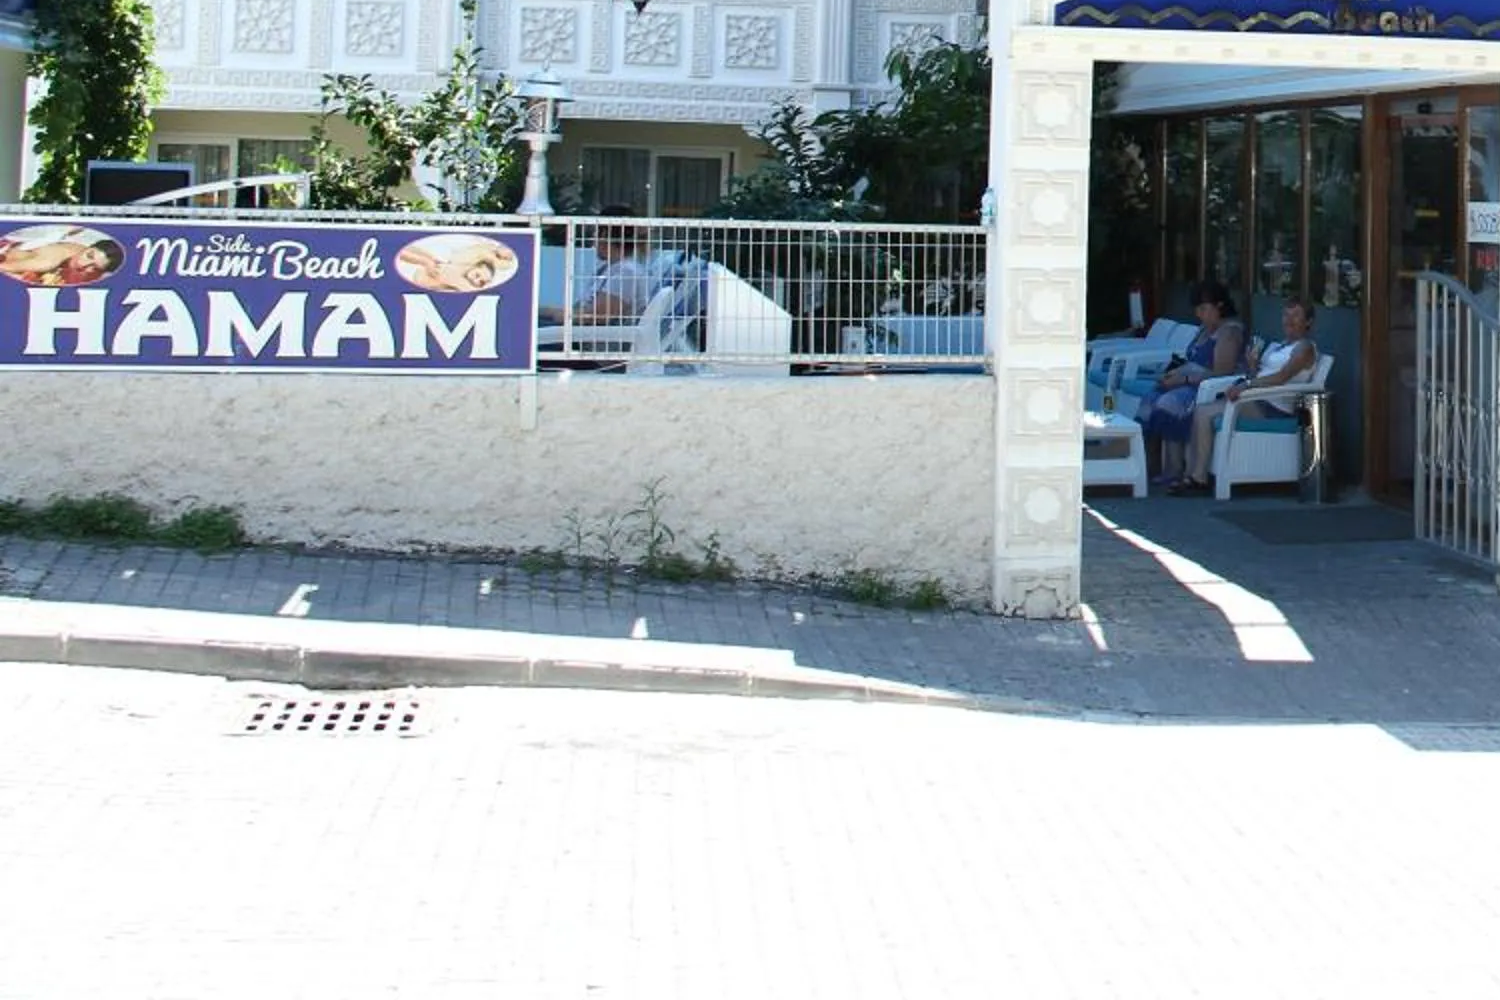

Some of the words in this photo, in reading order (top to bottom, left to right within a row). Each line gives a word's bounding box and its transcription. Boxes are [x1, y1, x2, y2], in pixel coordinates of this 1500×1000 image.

[136, 237, 267, 278] Miami
[268, 238, 385, 281] Beach
[207, 233, 254, 254] Side
[22, 287, 501, 360] HAMAM
